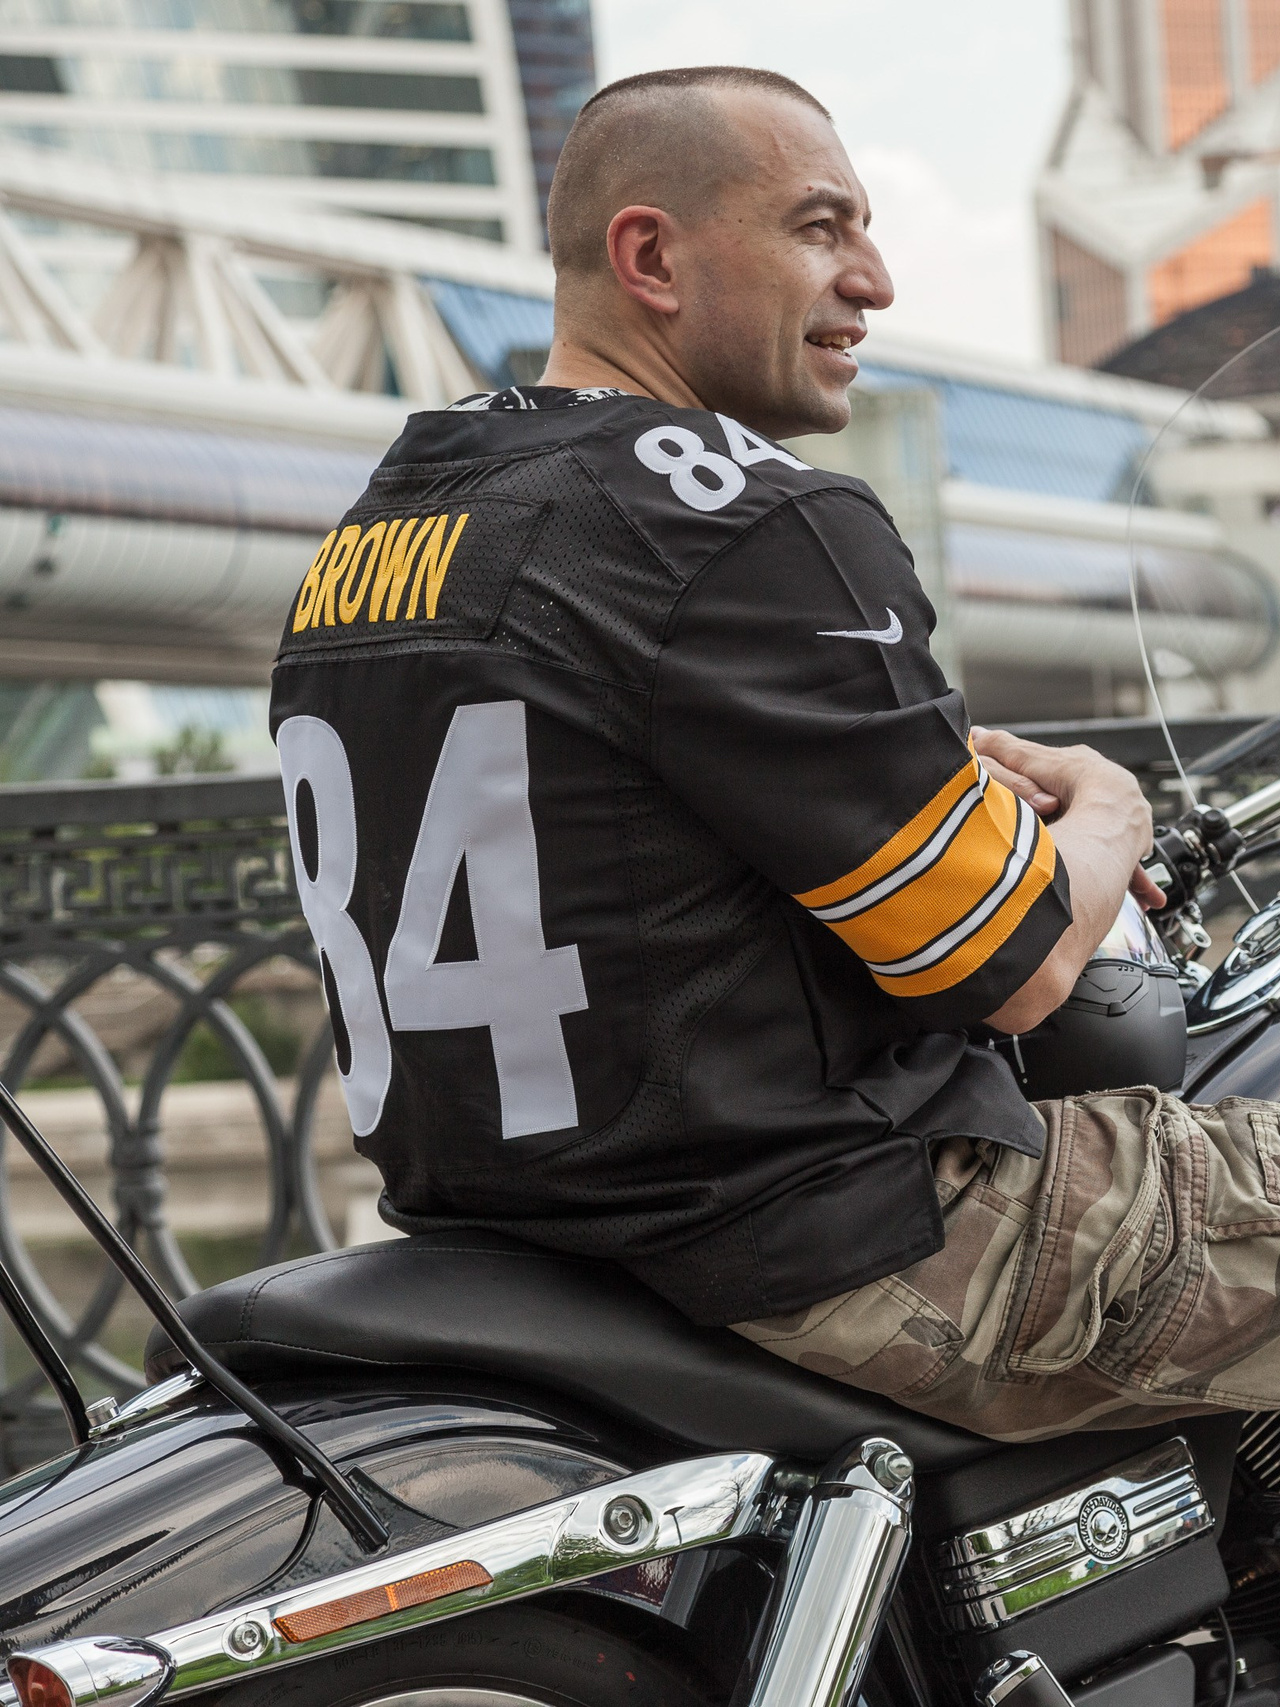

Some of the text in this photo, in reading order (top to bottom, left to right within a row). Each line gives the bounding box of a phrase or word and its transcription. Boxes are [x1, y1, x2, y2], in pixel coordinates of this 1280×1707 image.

[634, 412, 814, 512] 84
[293, 513, 469, 633] BROWN
[277, 700, 589, 1139] 84
